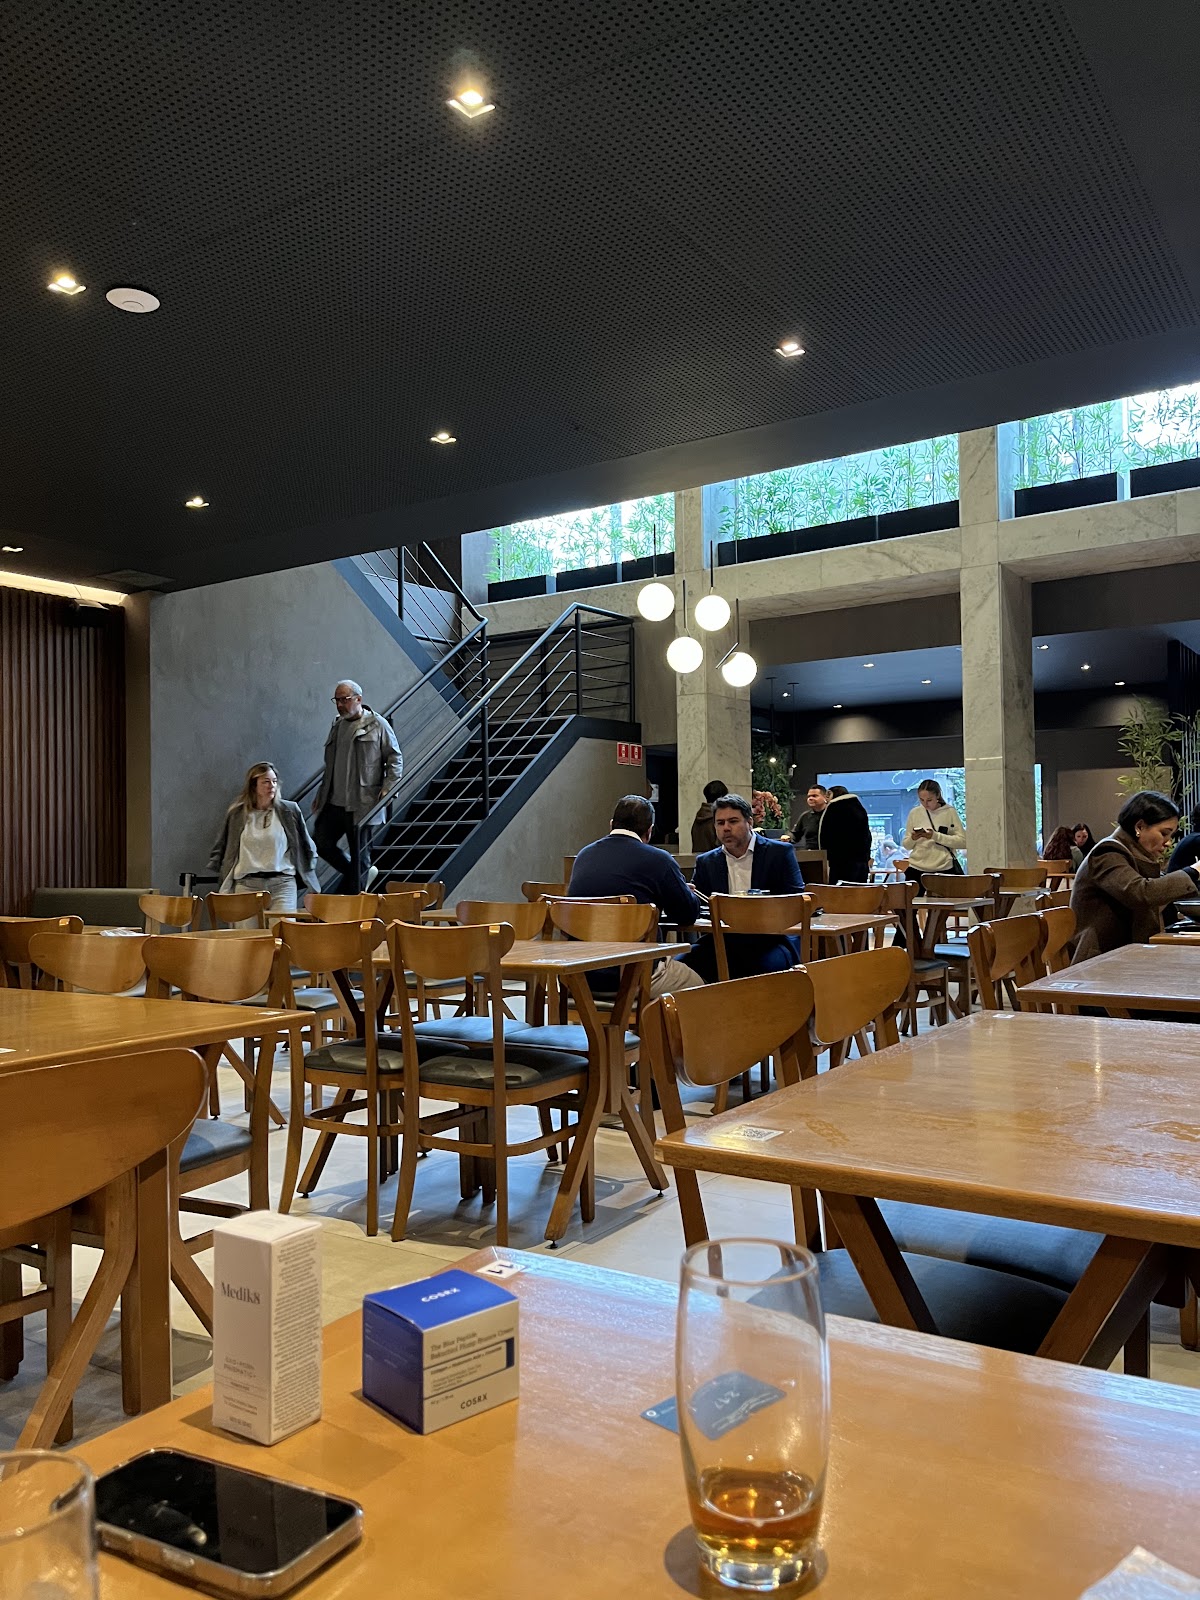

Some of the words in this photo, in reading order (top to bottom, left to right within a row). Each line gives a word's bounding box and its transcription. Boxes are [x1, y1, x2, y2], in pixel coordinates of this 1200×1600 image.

[221, 1281, 261, 1305] Medik8
[421, 1287, 461, 1302] COSRX
[460, 1393, 488, 1410] COSRX
